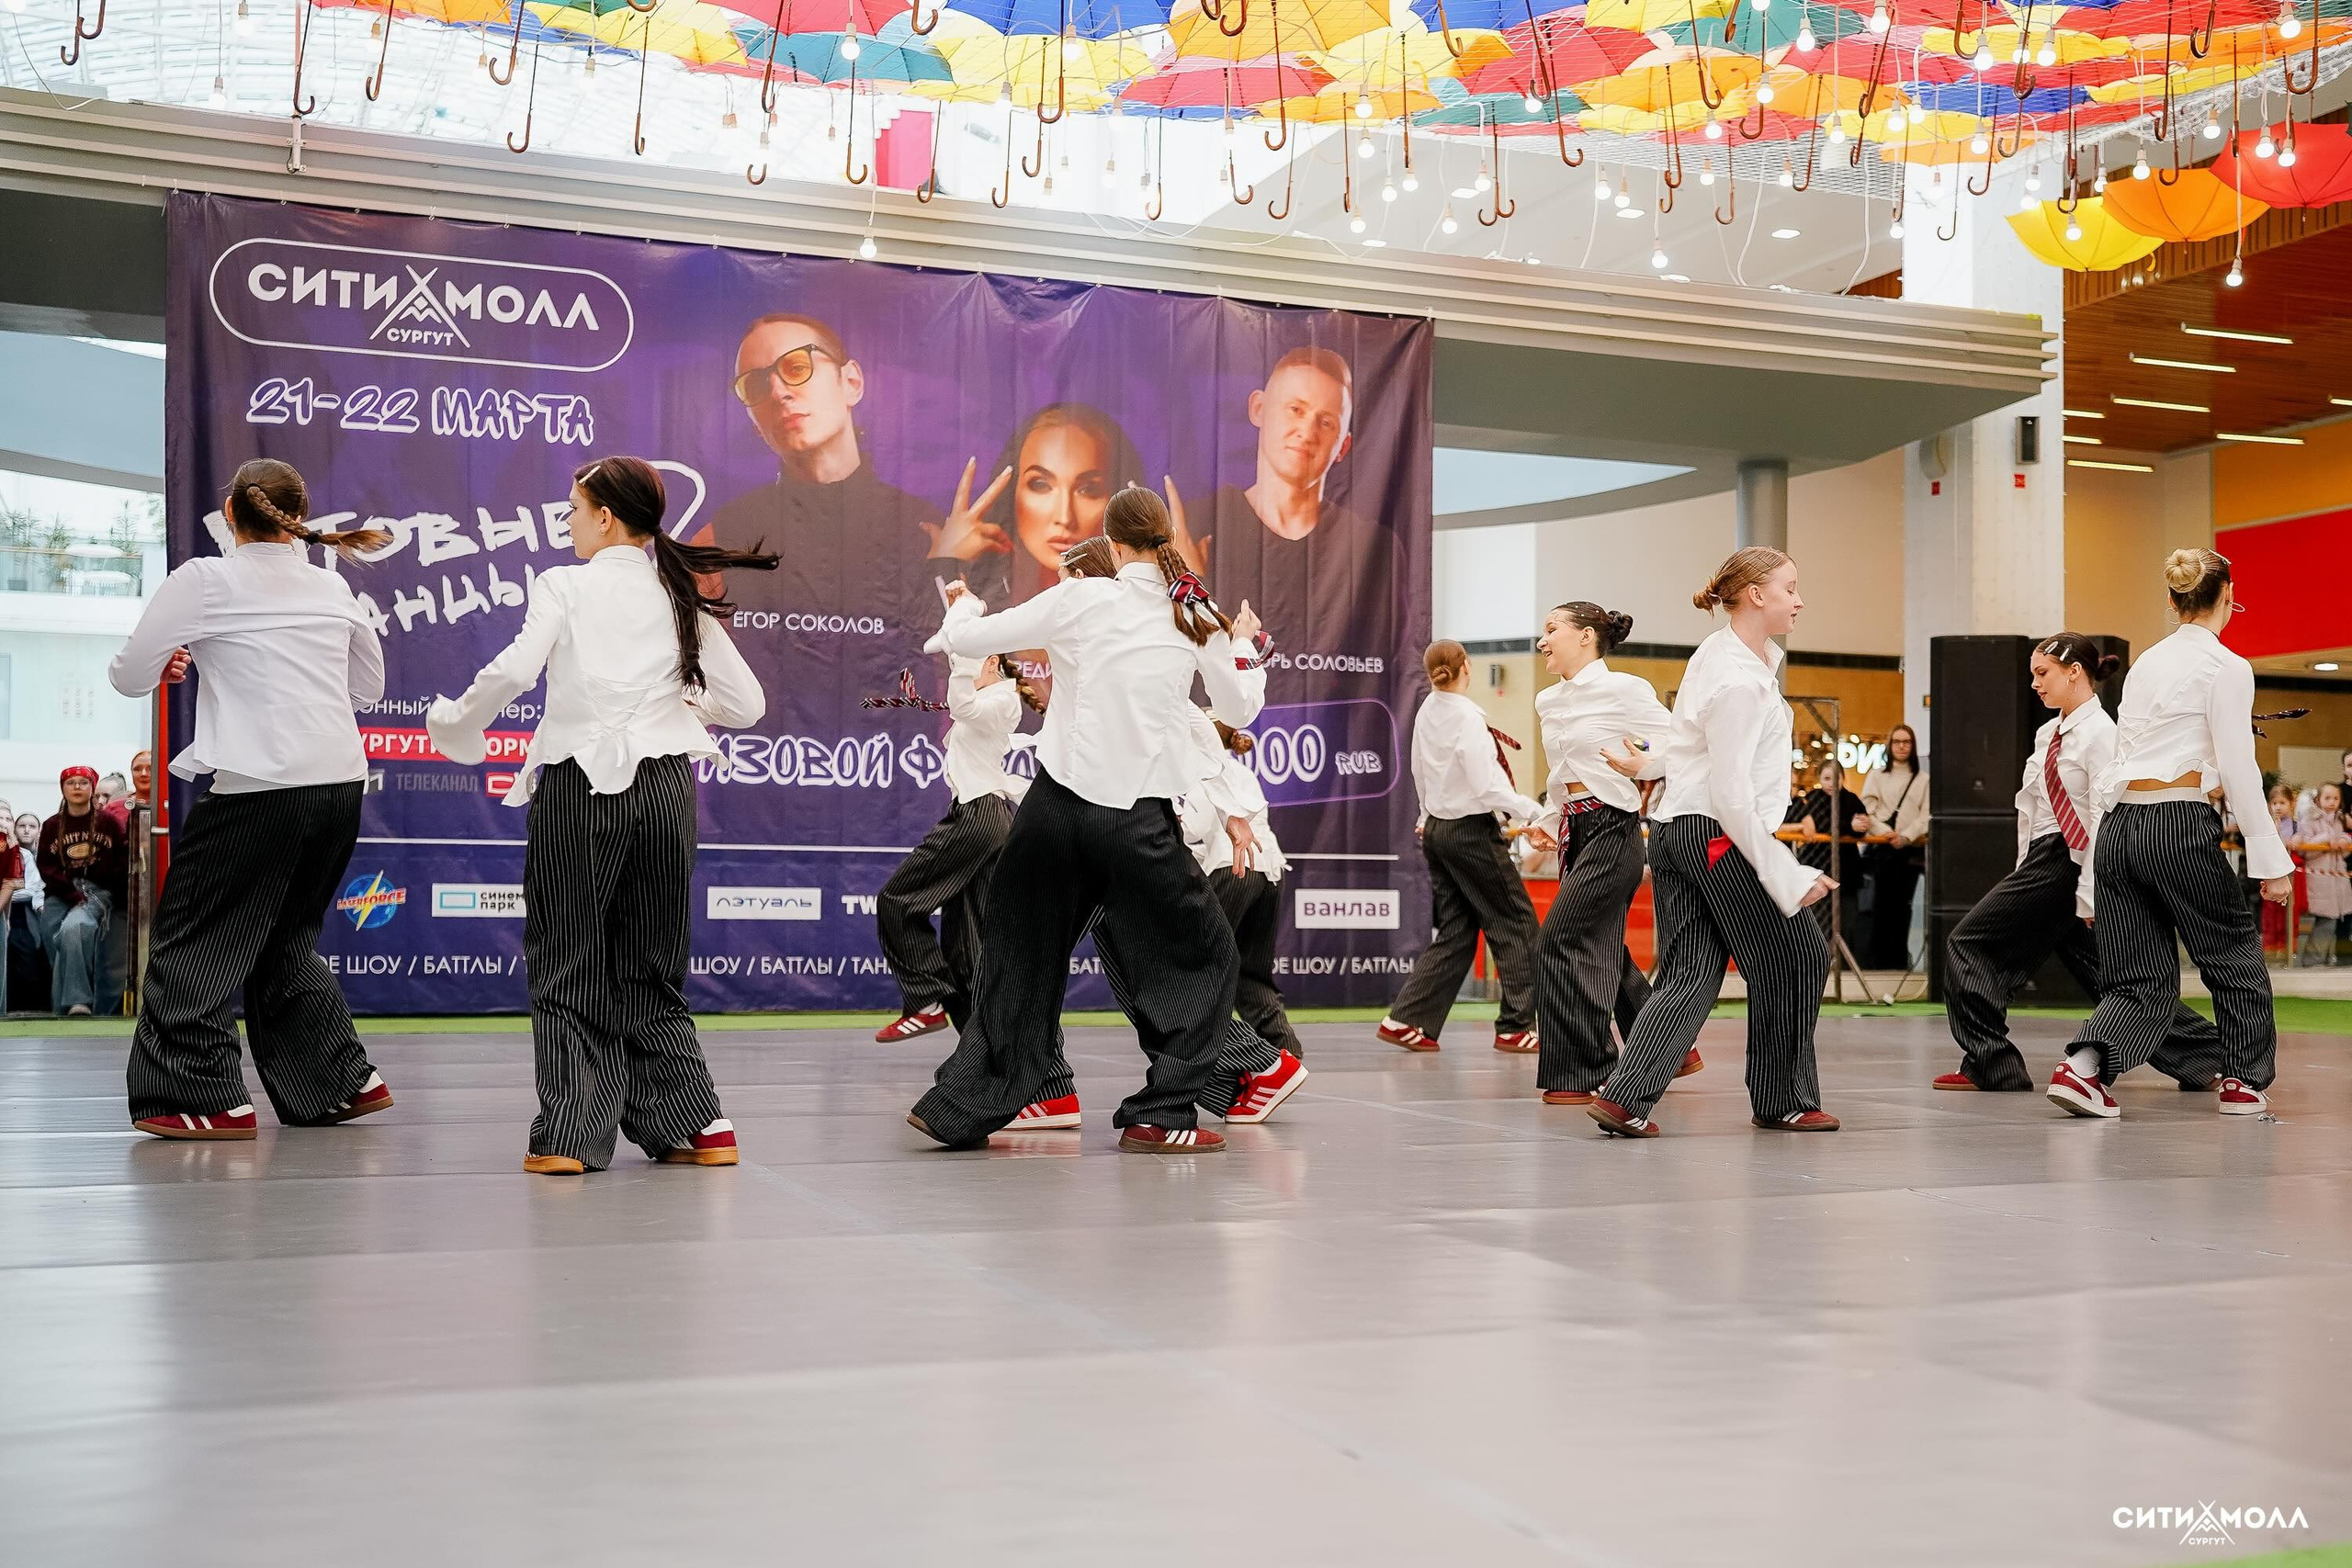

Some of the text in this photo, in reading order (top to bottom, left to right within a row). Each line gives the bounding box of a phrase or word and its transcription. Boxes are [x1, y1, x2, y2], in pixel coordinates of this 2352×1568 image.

[248, 263, 601, 332] СИТИ МОЛЛ
[386, 327, 454, 346] СУРГУТ
[246, 377, 594, 447] 21-22 МАРТА
[733, 611, 885, 635] ЕГОР СОКОЛОВ
[1295, 653, 1385, 673] СОЛОВЬЕВ
[1335, 750, 1383, 775] RUB
[396, 773, 480, 792] ТЕЛЕКАНАЛ
[481, 901, 515, 913] парк
[1303, 902, 1390, 917] ванлав
[346, 954, 401, 975] ШОУ
[424, 955, 502, 975] БАТТЛЫ
[690, 955, 741, 975] ШОУ
[761, 956, 832, 975] БАТТЛЫ
[1293, 955, 1337, 975] ШОУ
[1351, 956, 1414, 975] БАТТЛЫ
